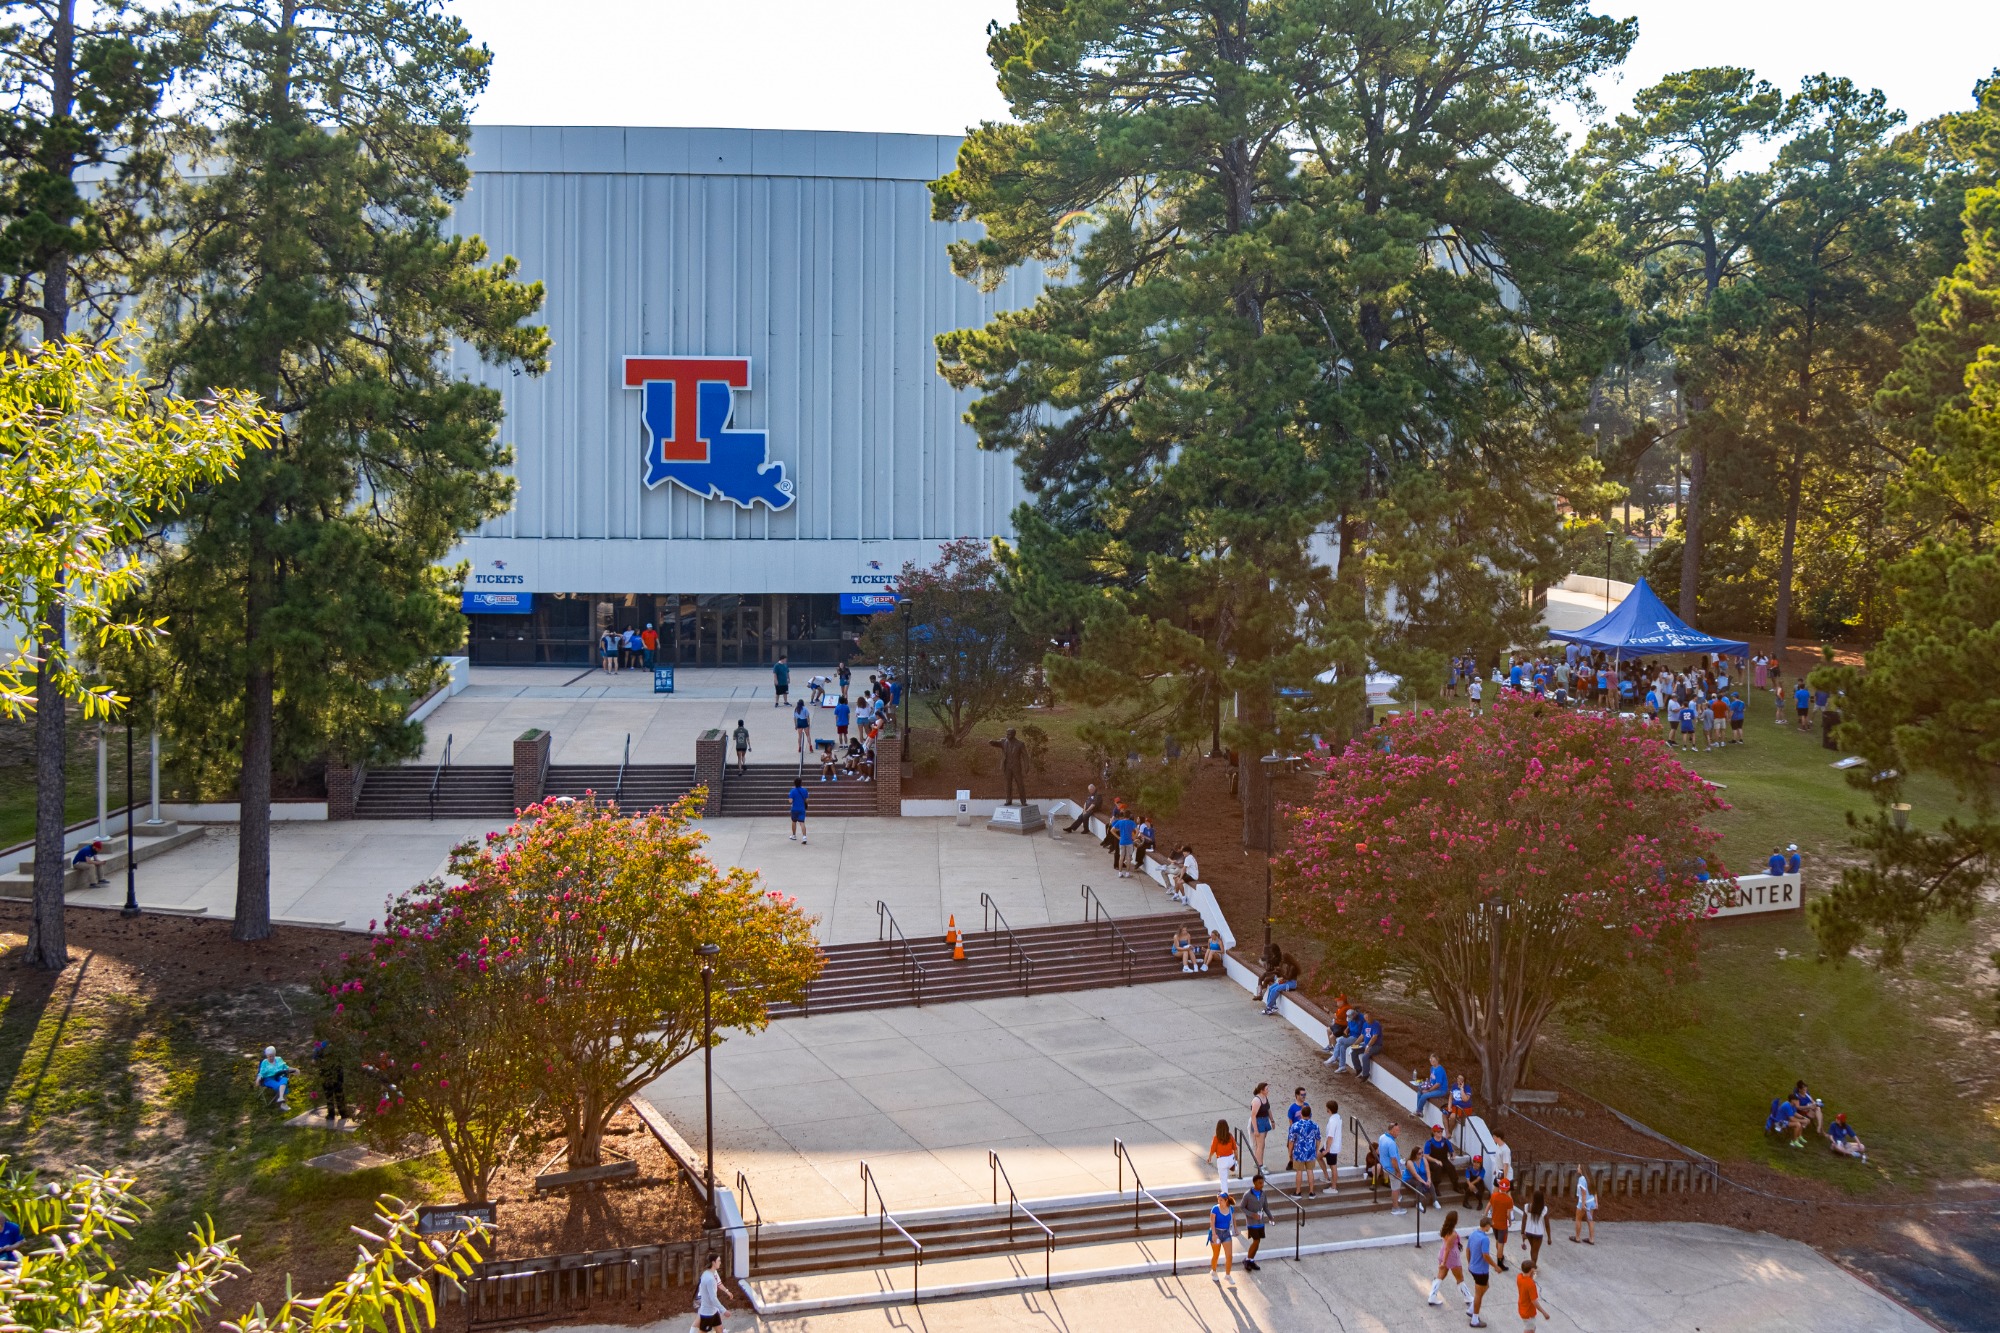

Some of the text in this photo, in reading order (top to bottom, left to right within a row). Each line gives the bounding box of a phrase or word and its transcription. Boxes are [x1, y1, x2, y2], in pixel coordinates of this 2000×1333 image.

[475, 574, 524, 584] TICKETS
[850, 575, 900, 584] TICKETS
[1629, 633, 1714, 645] FIRST RUSTON
[1683, 712, 1691, 720] 22
[468, 1208, 490, 1216] ENTRY
[435, 1218, 453, 1226] WEST
